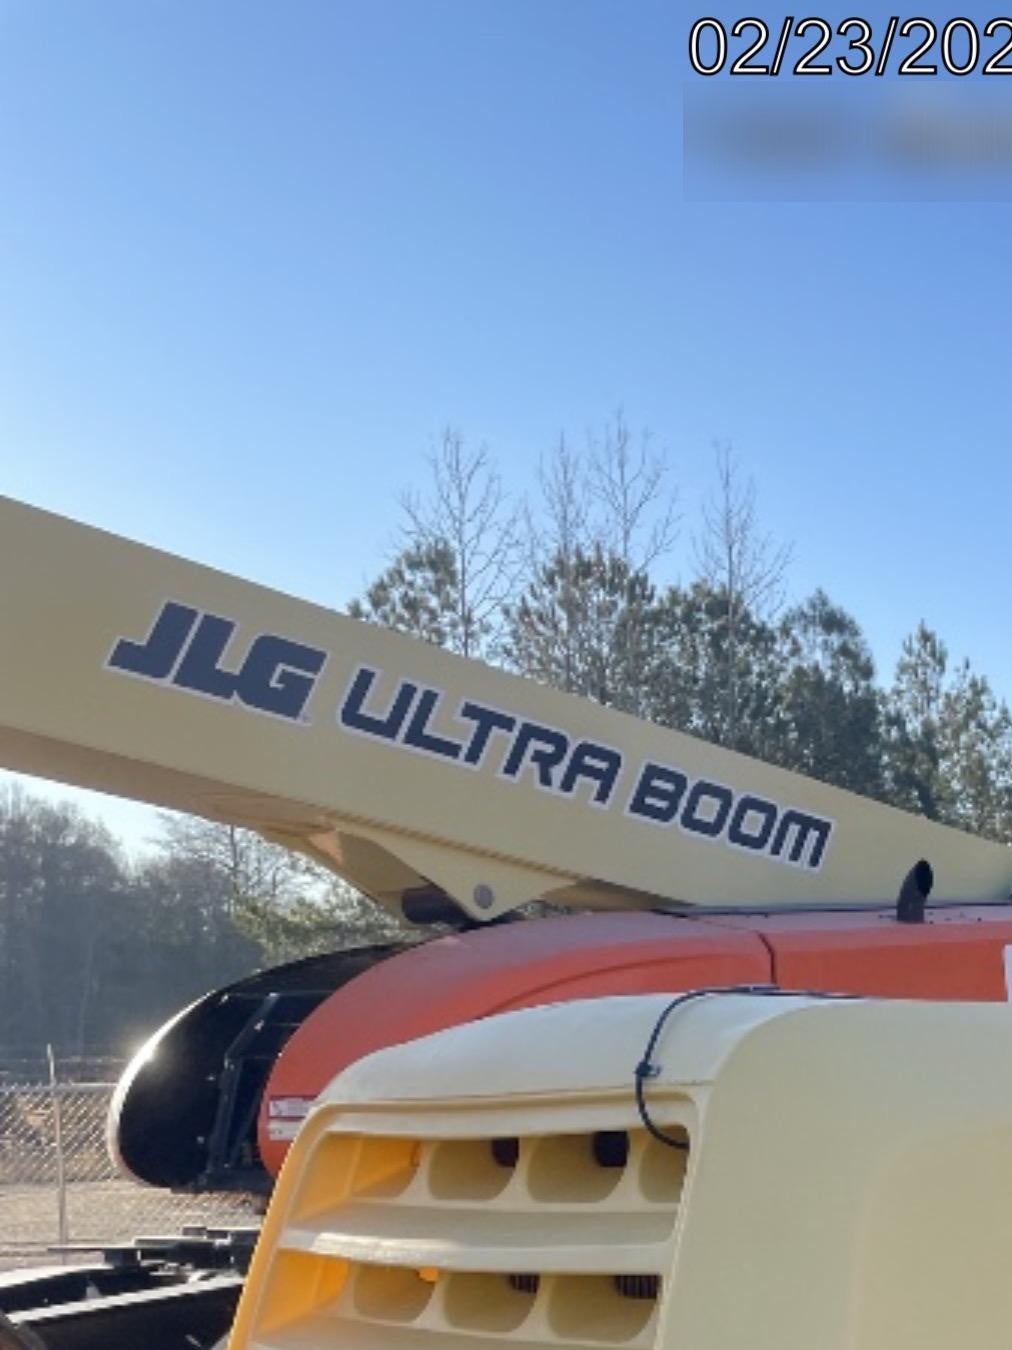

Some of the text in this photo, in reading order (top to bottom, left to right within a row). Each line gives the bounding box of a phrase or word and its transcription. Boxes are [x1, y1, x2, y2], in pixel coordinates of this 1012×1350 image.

[107, 600, 832, 868] JLG ULTRA BOOM
